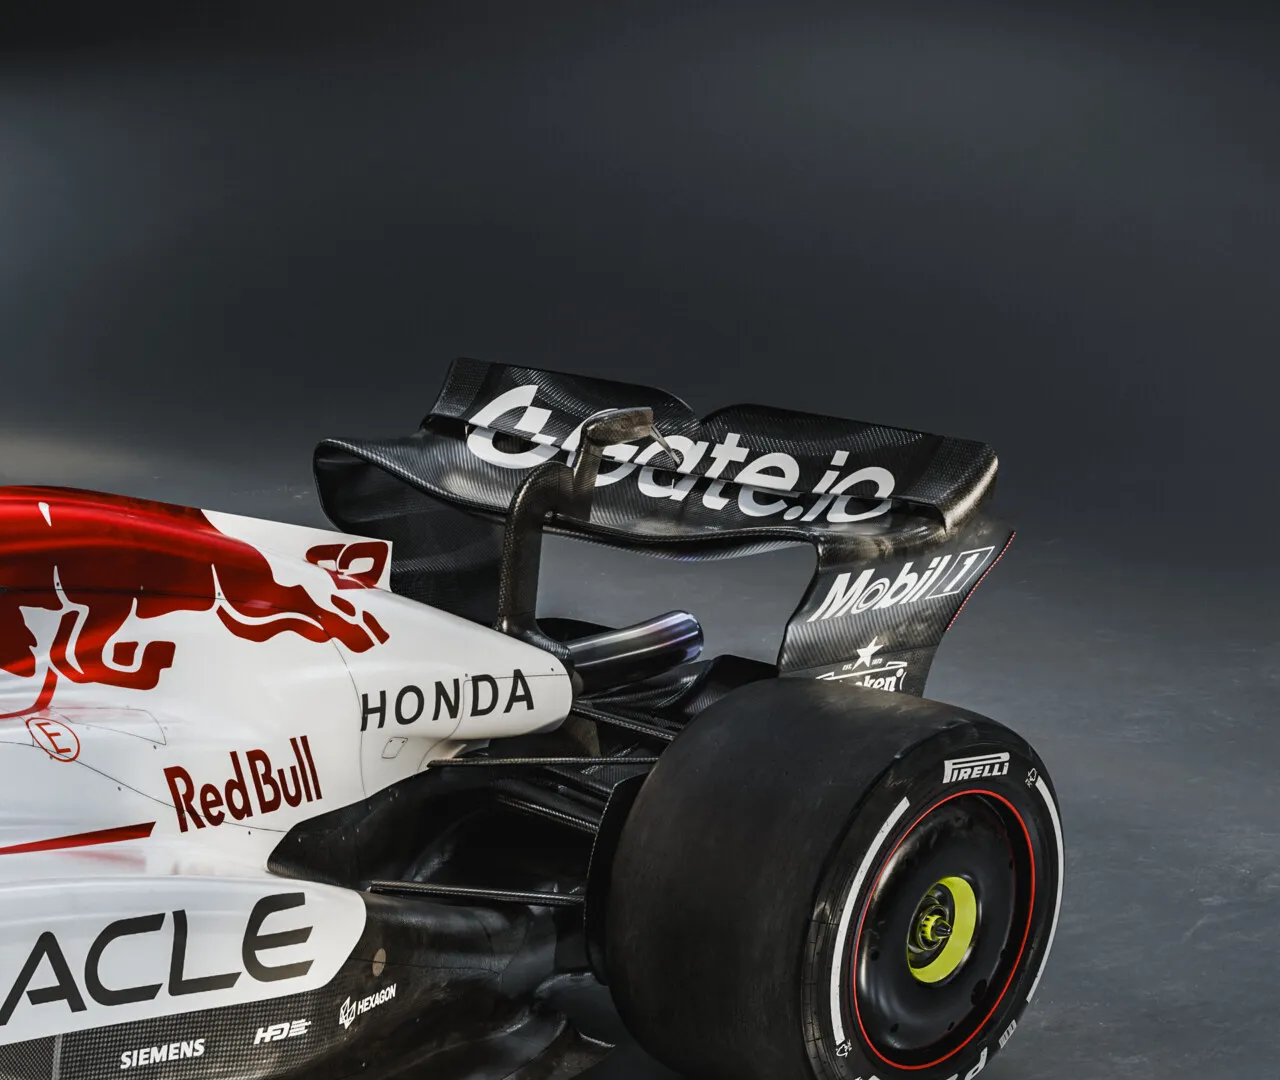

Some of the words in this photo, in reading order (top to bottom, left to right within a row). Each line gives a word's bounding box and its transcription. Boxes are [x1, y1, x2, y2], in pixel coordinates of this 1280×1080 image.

[806, 554, 952, 622] Mobil
[360, 669, 535, 731] HONDA
[942, 752, 1010, 784] PIRELLI
[357, 983, 397, 1016] HEXAGON
[120, 1038, 205, 1070] SIEMENS
